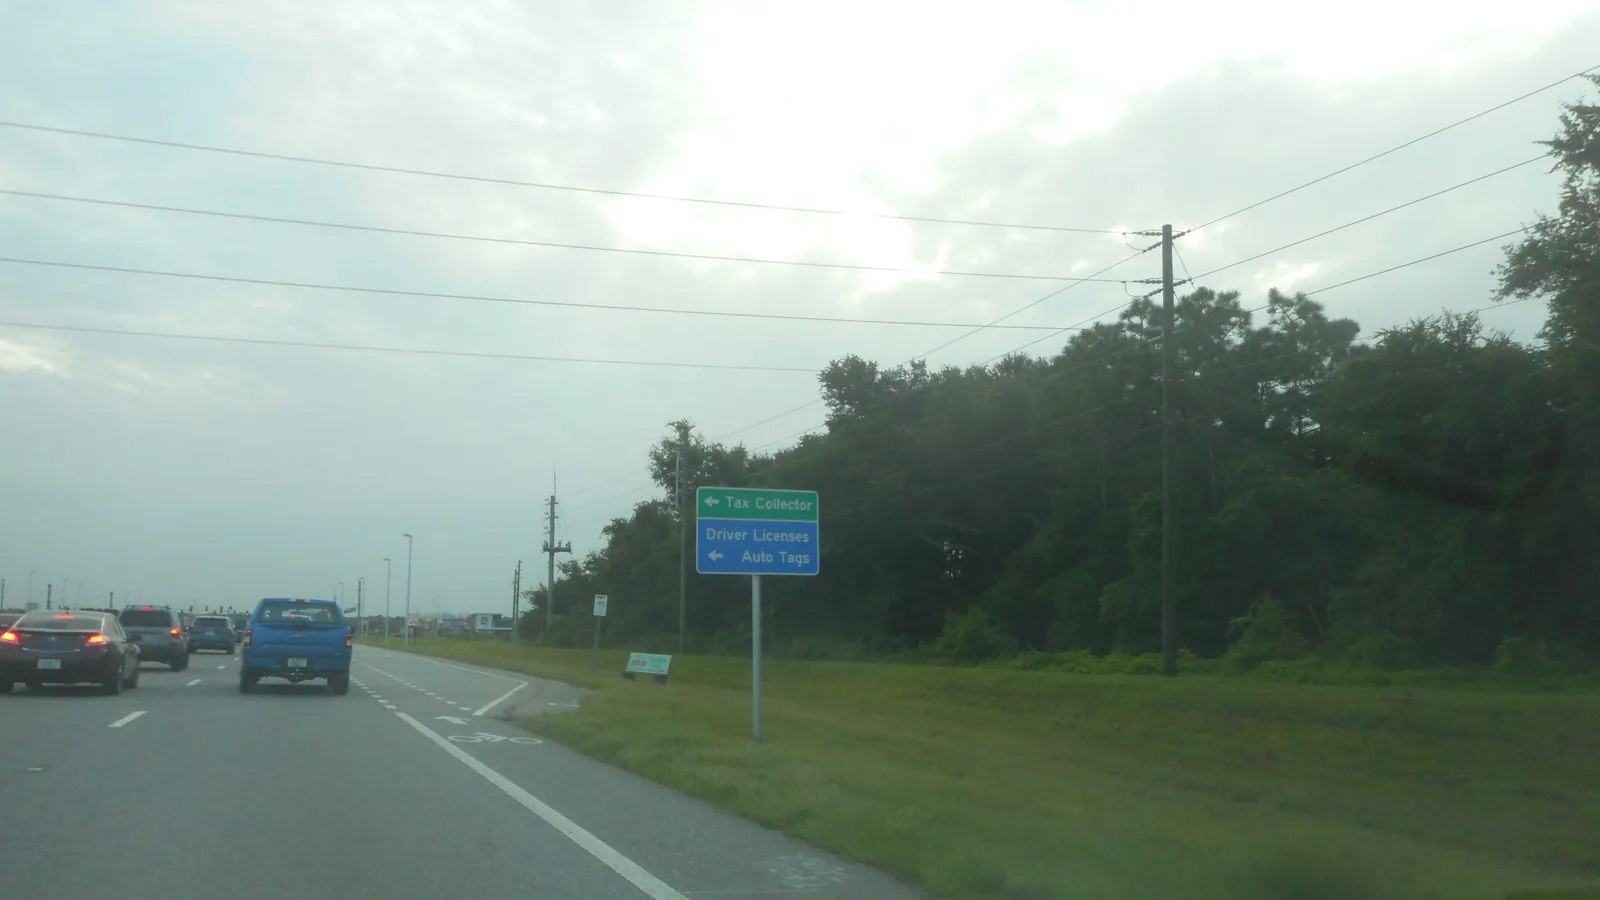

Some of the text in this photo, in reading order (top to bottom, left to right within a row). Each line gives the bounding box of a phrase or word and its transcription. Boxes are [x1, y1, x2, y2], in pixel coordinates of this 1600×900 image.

[726, 496, 812, 511] Tax Collector
[706, 528, 810, 543] Driver Licenses
[741, 550, 811, 567] Auto Tags
